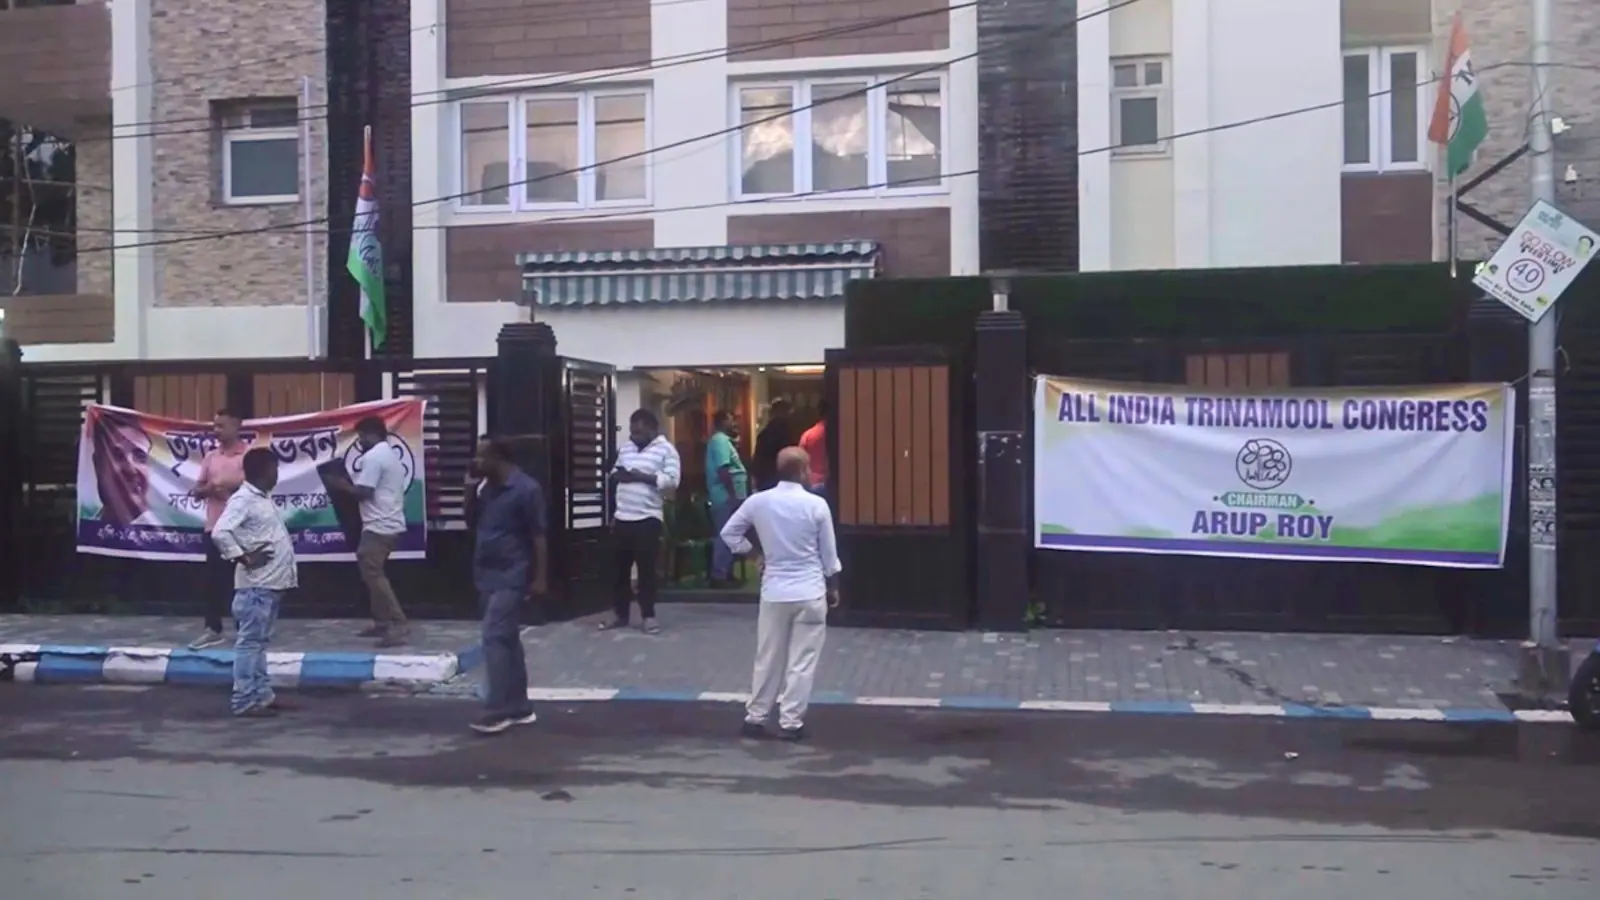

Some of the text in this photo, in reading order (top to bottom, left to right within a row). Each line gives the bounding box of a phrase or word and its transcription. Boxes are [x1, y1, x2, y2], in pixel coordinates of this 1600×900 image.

[1541, 242, 1576, 268] SLOW
[1514, 262, 1540, 284] 40
[1058, 392, 1488, 432] ALL INDIA TRINAMOOL CONGRESS
[1227, 493, 1297, 509] CHAIRMAN
[1191, 510, 1334, 538] ARUP ROY
